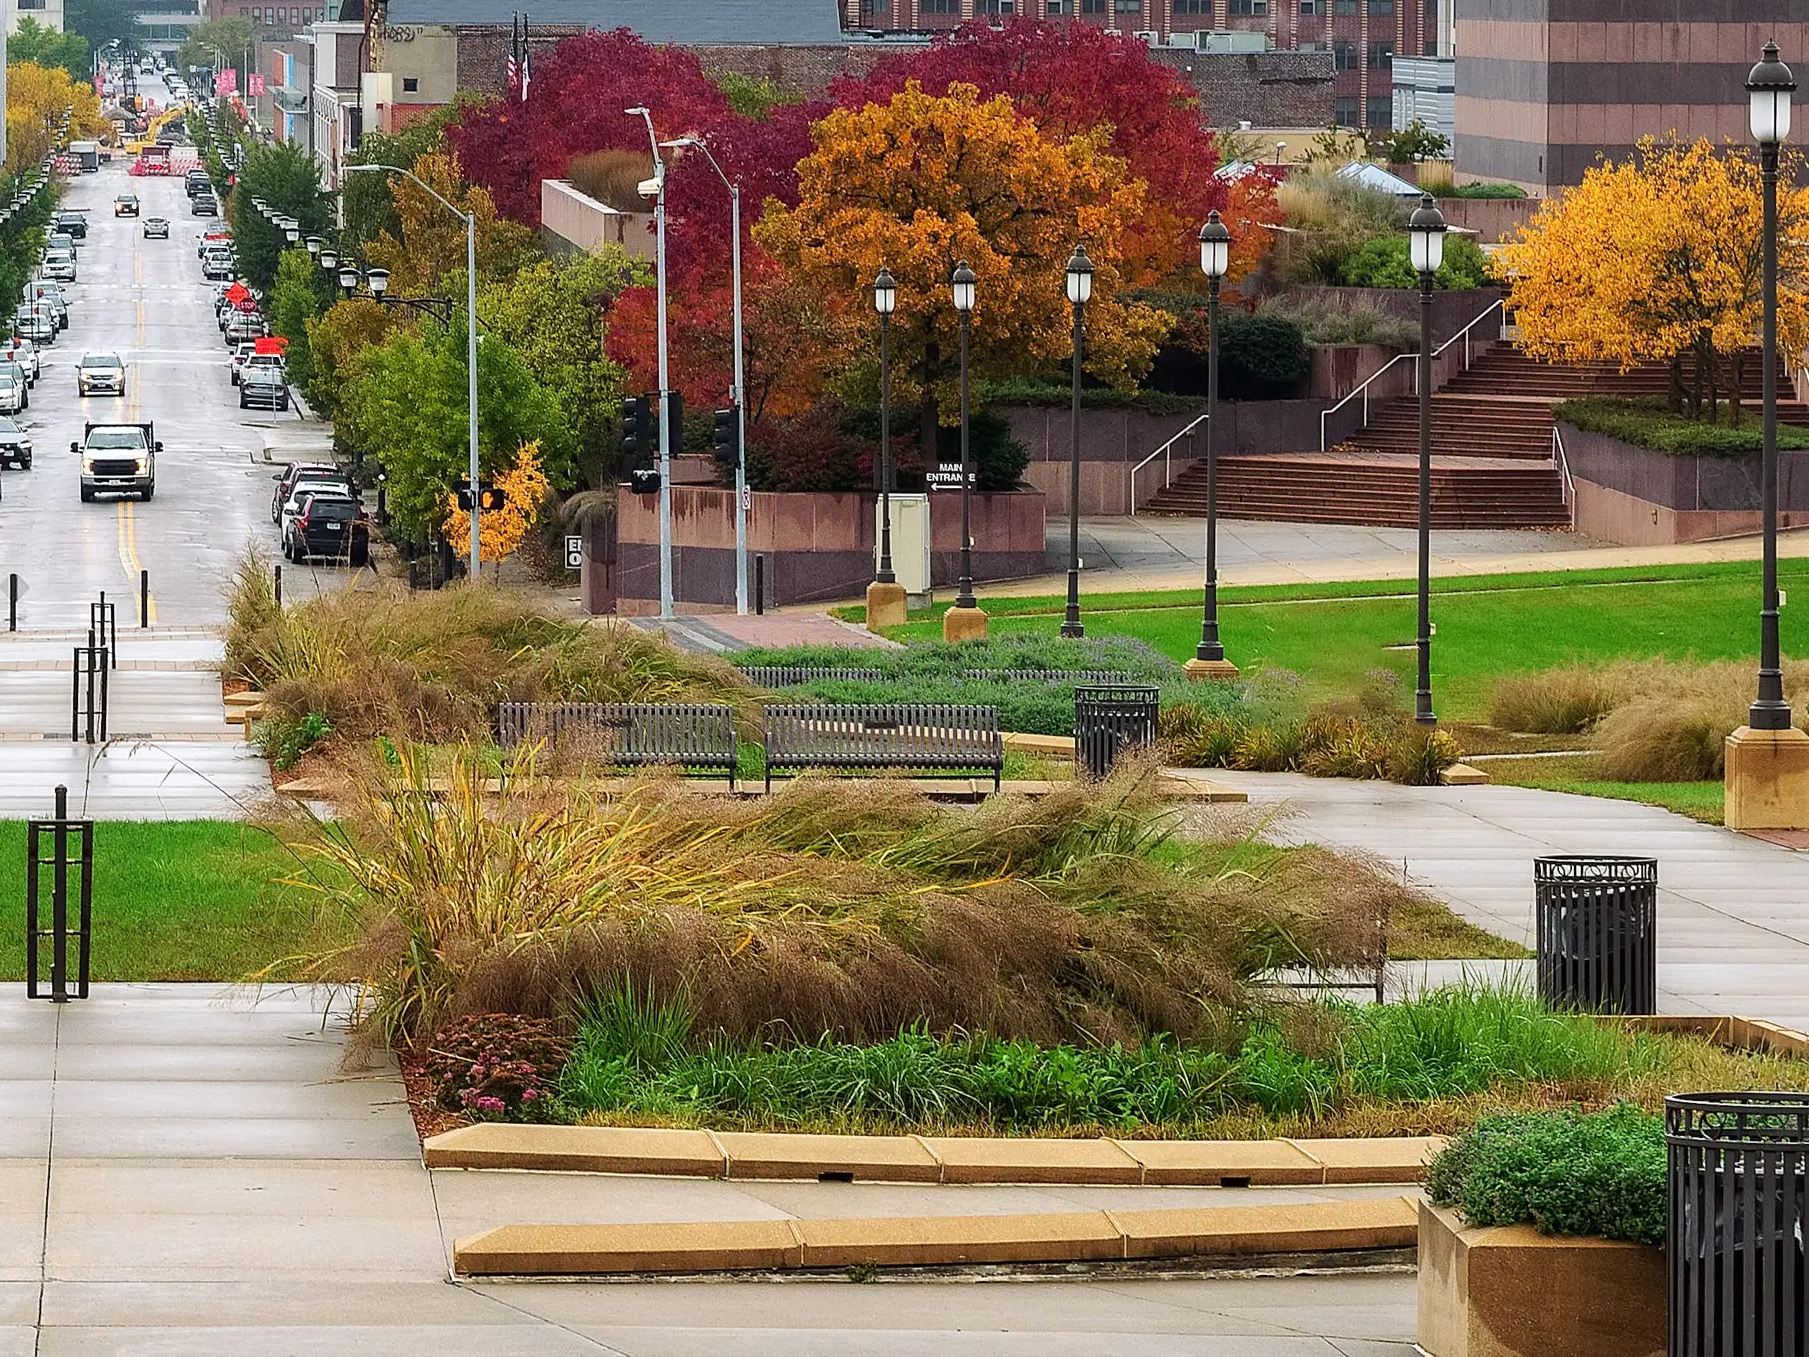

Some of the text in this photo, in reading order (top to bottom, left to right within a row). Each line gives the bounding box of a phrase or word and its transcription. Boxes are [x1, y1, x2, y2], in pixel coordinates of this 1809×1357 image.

[240, 301, 255, 310] STOP
[939, 463, 963, 472] MAIN
[926, 472, 976, 482] ENTRANE
